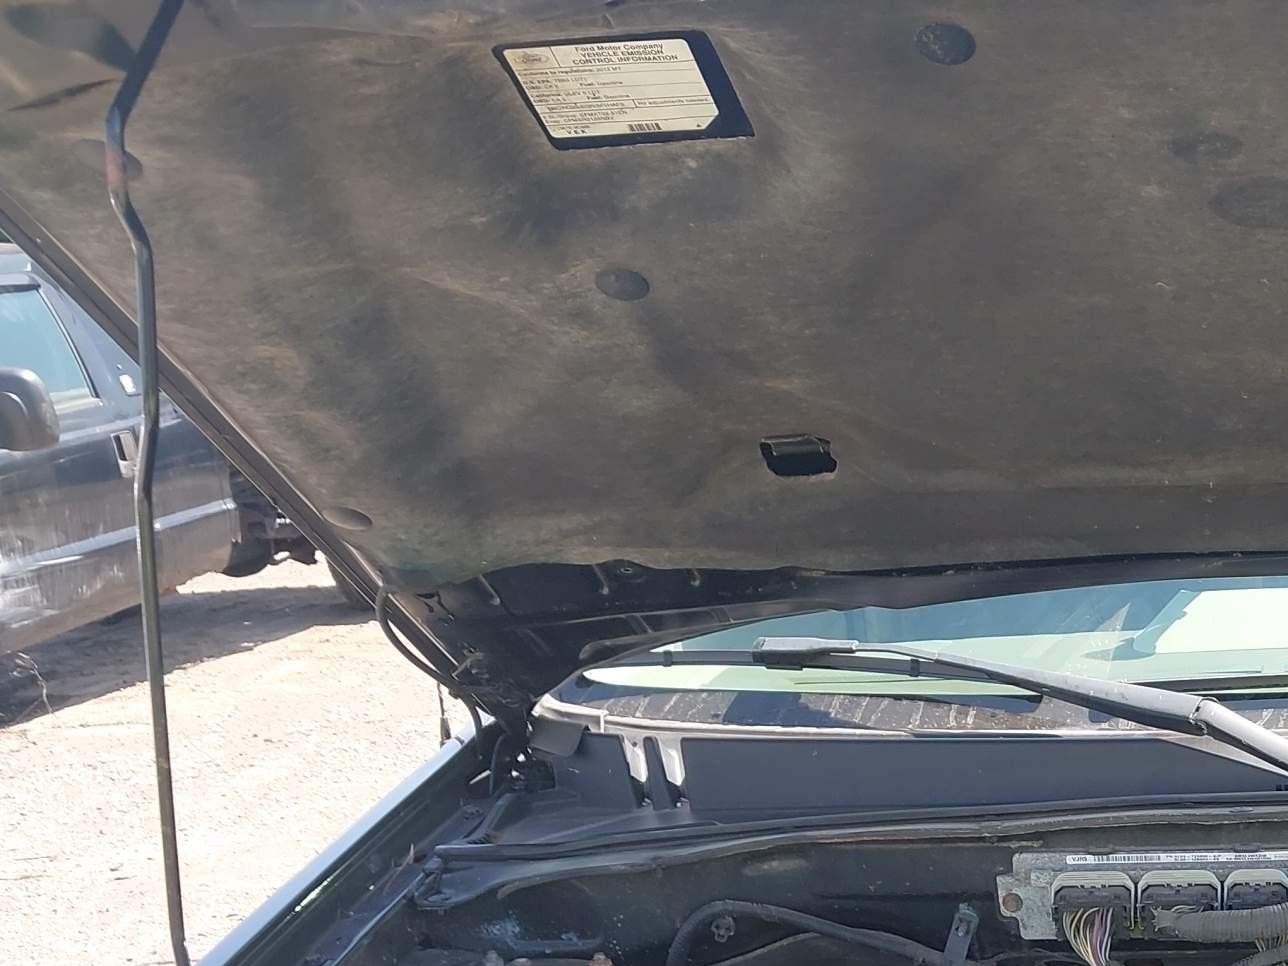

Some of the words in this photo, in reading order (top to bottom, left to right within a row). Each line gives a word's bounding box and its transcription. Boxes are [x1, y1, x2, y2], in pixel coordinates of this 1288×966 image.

[623, 42, 663, 51] Company
[580, 50, 619, 58] VEHICLE
[621, 48, 664, 56] EMISSION
[572, 56, 615, 65] CONTROL
[617, 54, 678, 62] INFORMATION
